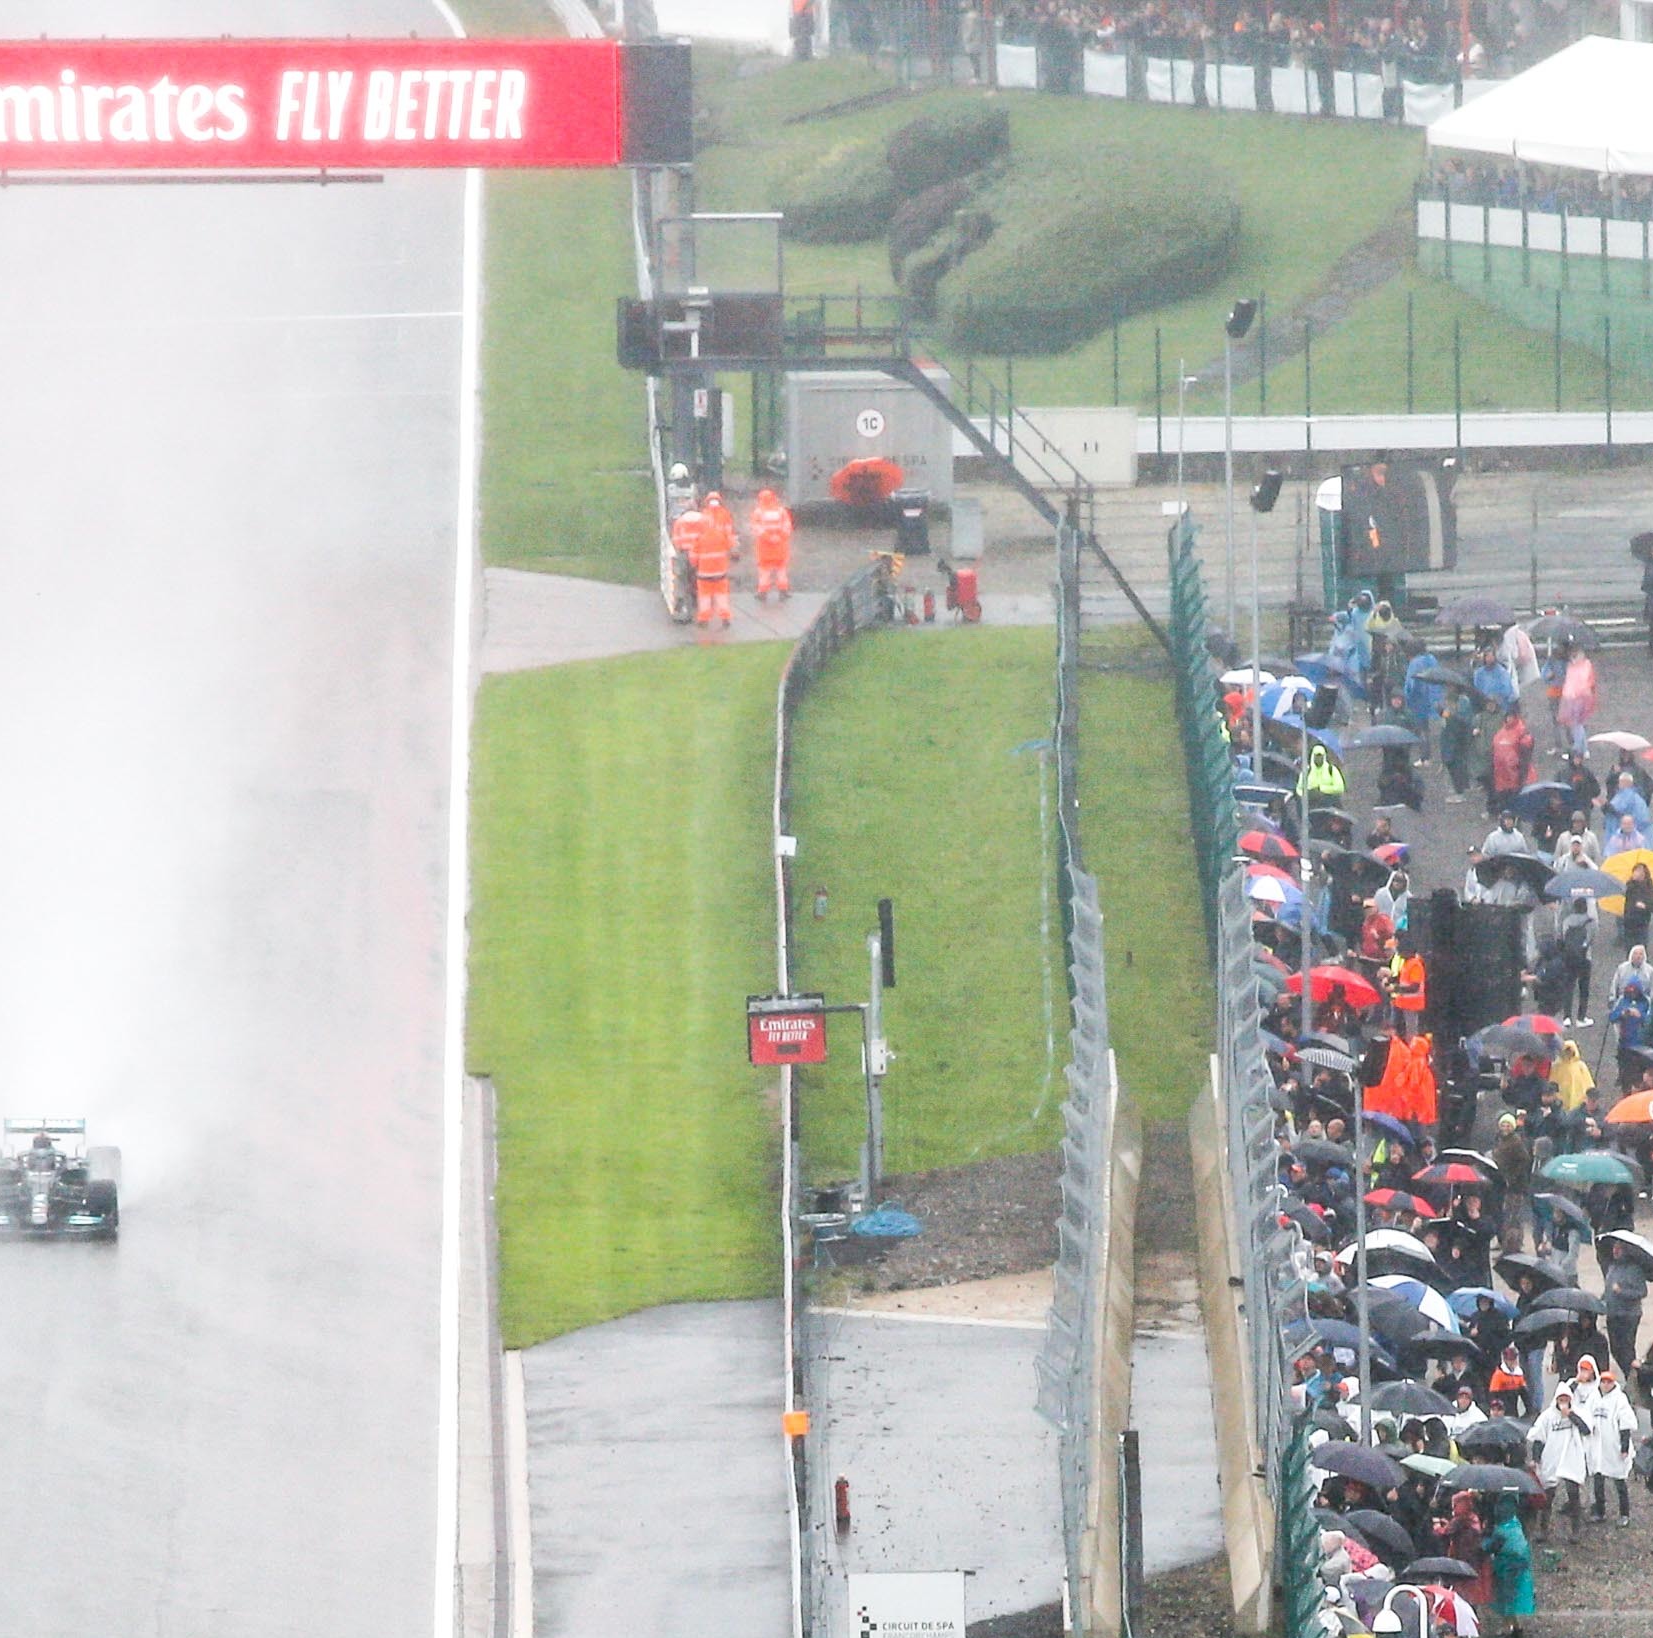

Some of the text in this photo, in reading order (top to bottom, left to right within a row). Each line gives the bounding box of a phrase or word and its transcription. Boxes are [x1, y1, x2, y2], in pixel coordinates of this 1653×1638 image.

[276, 70, 353, 141] FLY
[362, 69, 527, 140] BETTER
[862, 416, 879, 430] 1C
[759, 1018, 816, 1032] Emirates
[882, 1621, 955, 1631] CIRCUIT DE SPA
